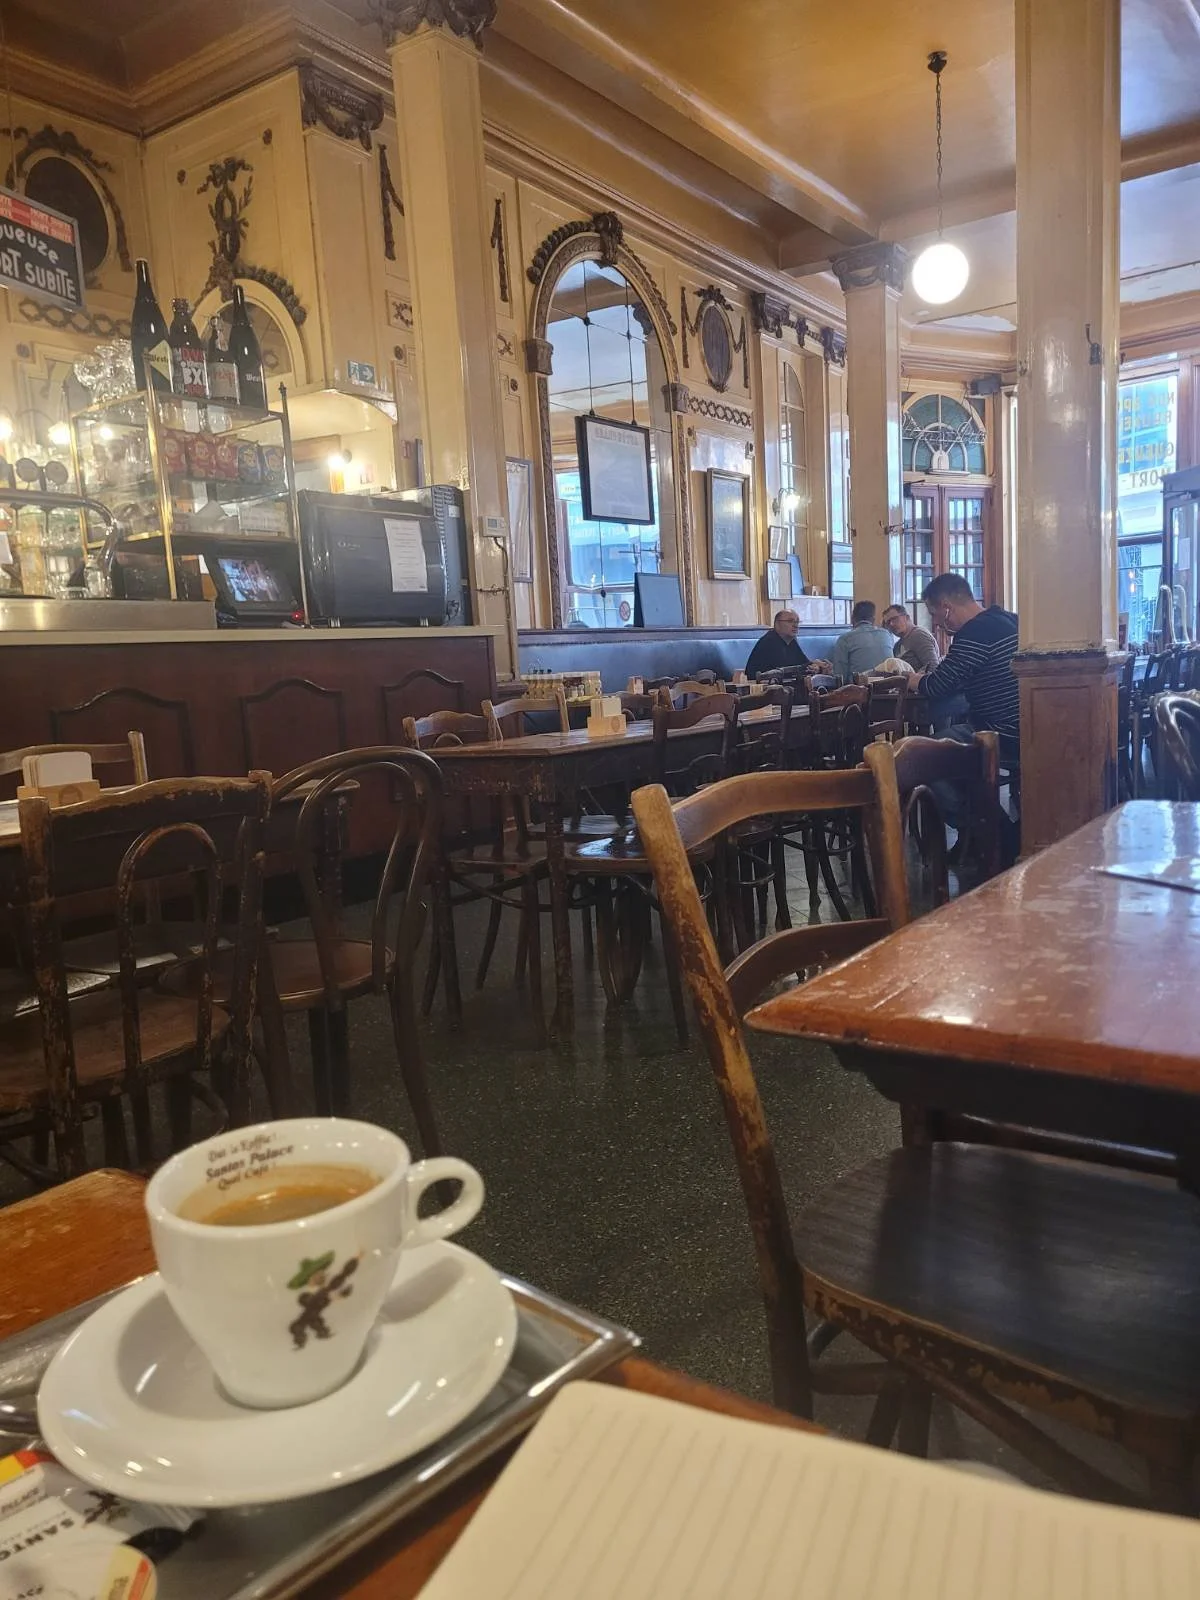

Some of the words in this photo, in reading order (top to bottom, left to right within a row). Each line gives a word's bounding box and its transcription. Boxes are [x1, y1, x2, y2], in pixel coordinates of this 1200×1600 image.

[0, 223, 59, 265] ueuze
[0, 247, 21, 279] RT
[24, 262, 77, 300] SUBITE
[206, 1159, 245, 1180] Santos
[250, 1144, 294, 1165] Palace
